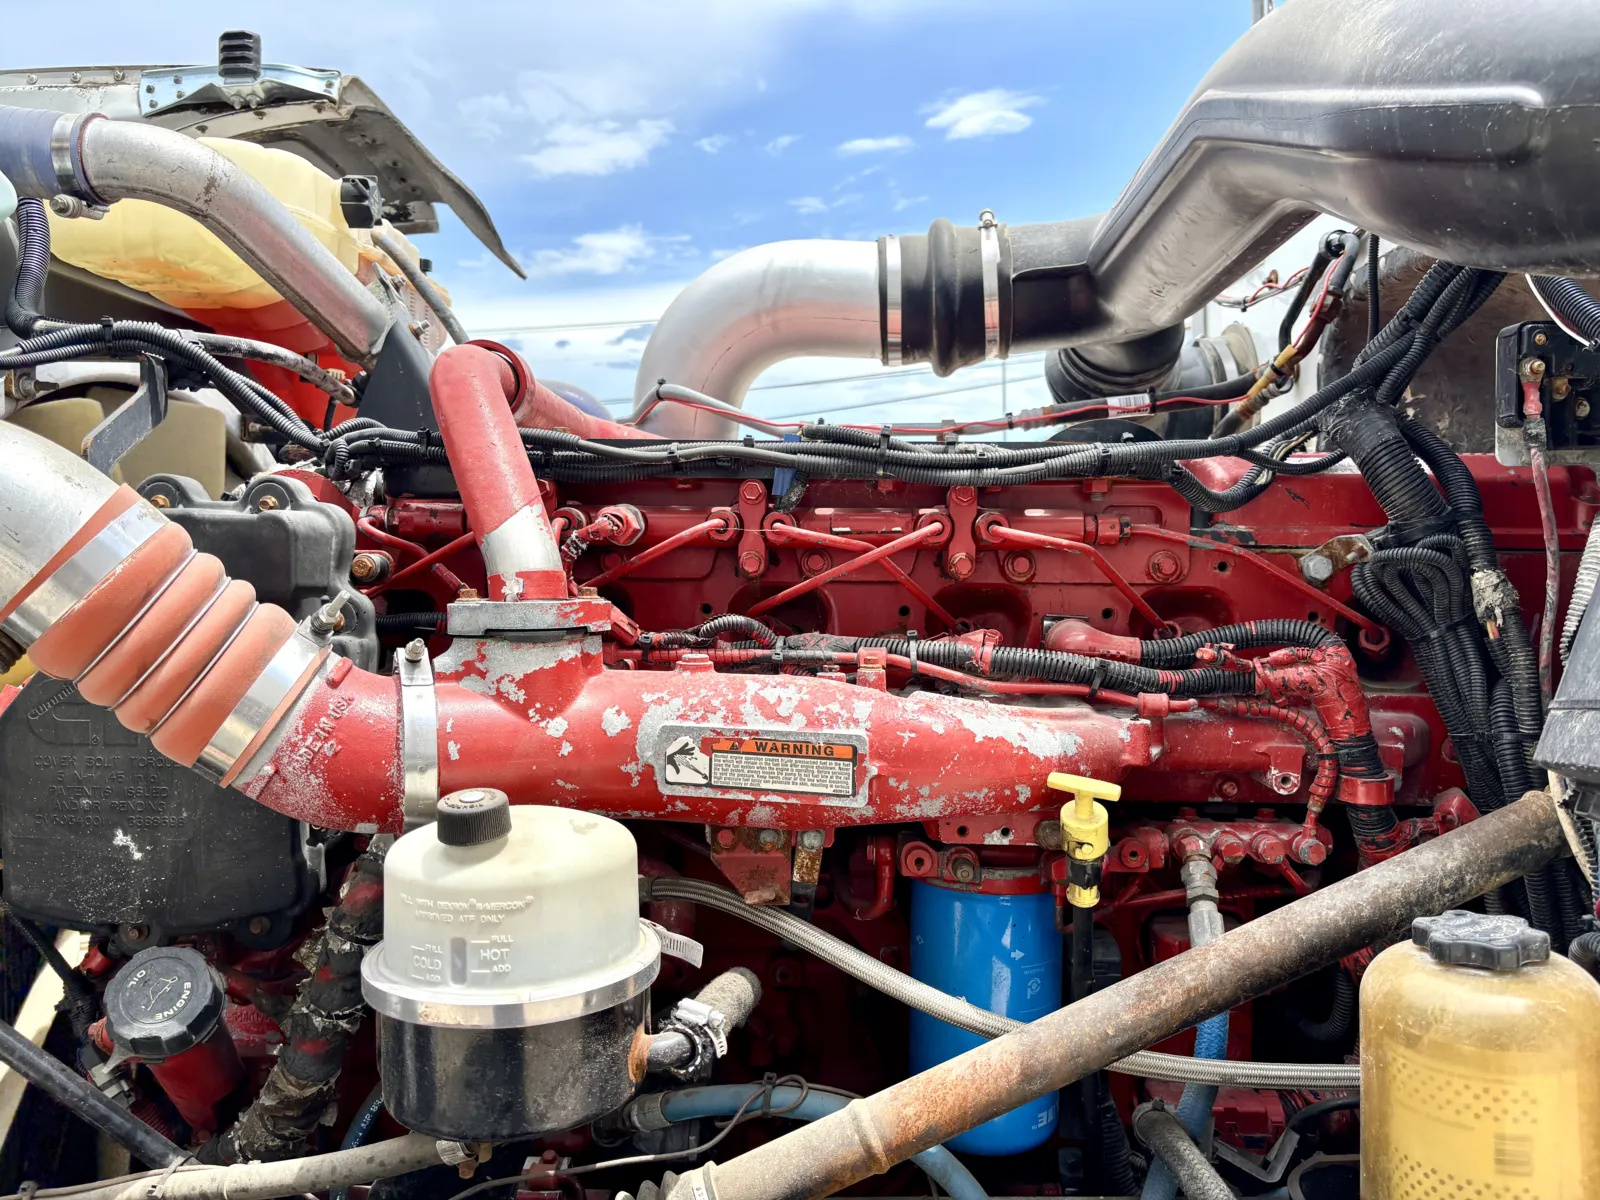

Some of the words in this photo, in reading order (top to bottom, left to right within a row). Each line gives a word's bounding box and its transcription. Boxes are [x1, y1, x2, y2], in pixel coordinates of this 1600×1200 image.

[28, 684, 78, 720] Cummin
[314, 716, 336, 739] IN
[328, 696, 354, 718] USA
[754, 741, 834, 756] WARNING
[35, 756, 77, 766] COVER
[84, 756, 121, 766] BOLT
[124, 786, 169, 798] ISSUED
[110, 800, 166, 812] PENDING
[458, 914, 476, 923] ATF
[480, 914, 505, 923] ONLY
[491, 934, 514, 943] FULL
[426, 944, 443, 954] FULL
[480, 948, 510, 961] HOT
[414, 955, 442, 970] COLD
[492, 964, 512, 973] ADD
[426, 974, 441, 982] ADD
[128, 969, 146, 988] OIL
[155, 981, 192, 1020] ENGINE
